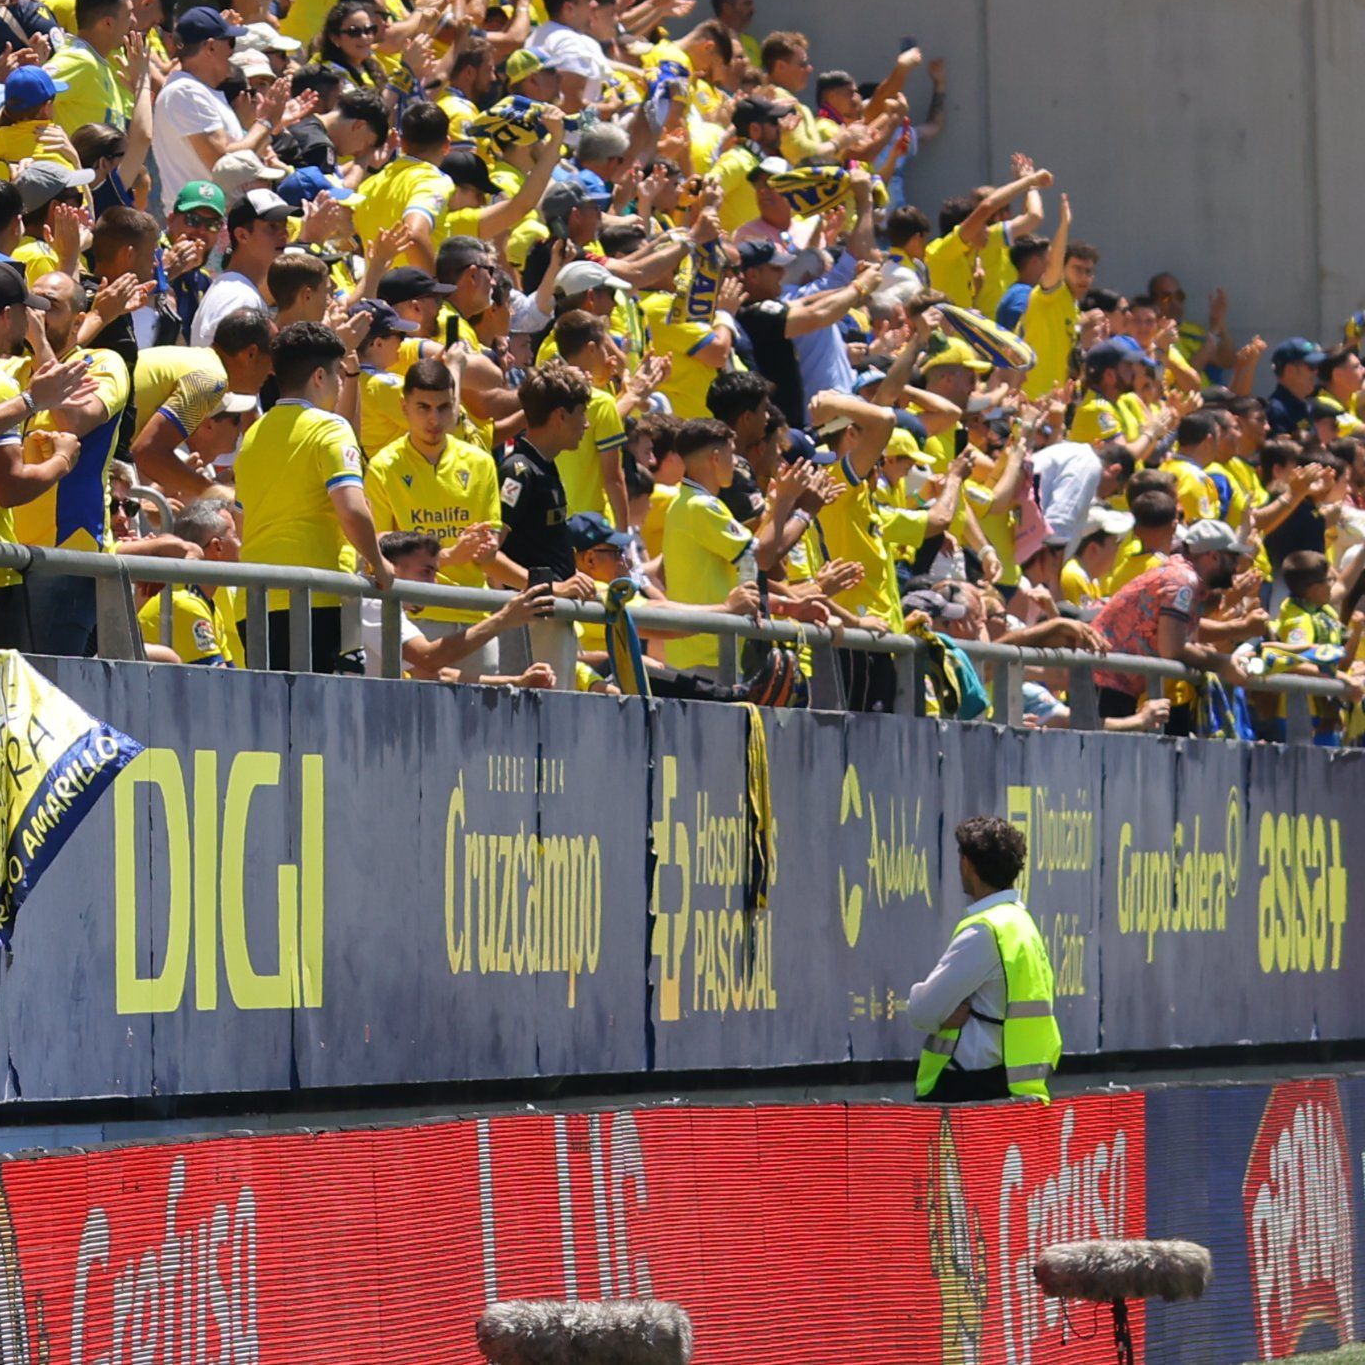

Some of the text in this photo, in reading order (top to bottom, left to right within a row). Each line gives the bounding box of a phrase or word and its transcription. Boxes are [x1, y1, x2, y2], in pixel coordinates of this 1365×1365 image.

[410, 507, 469, 524] Khalifa
[22, 734, 120, 860] AMARILLO
[114, 747, 325, 1015] DIGI
[444, 769, 602, 1009] Cruzcampo
[694, 909, 778, 1012] PASCUAL
